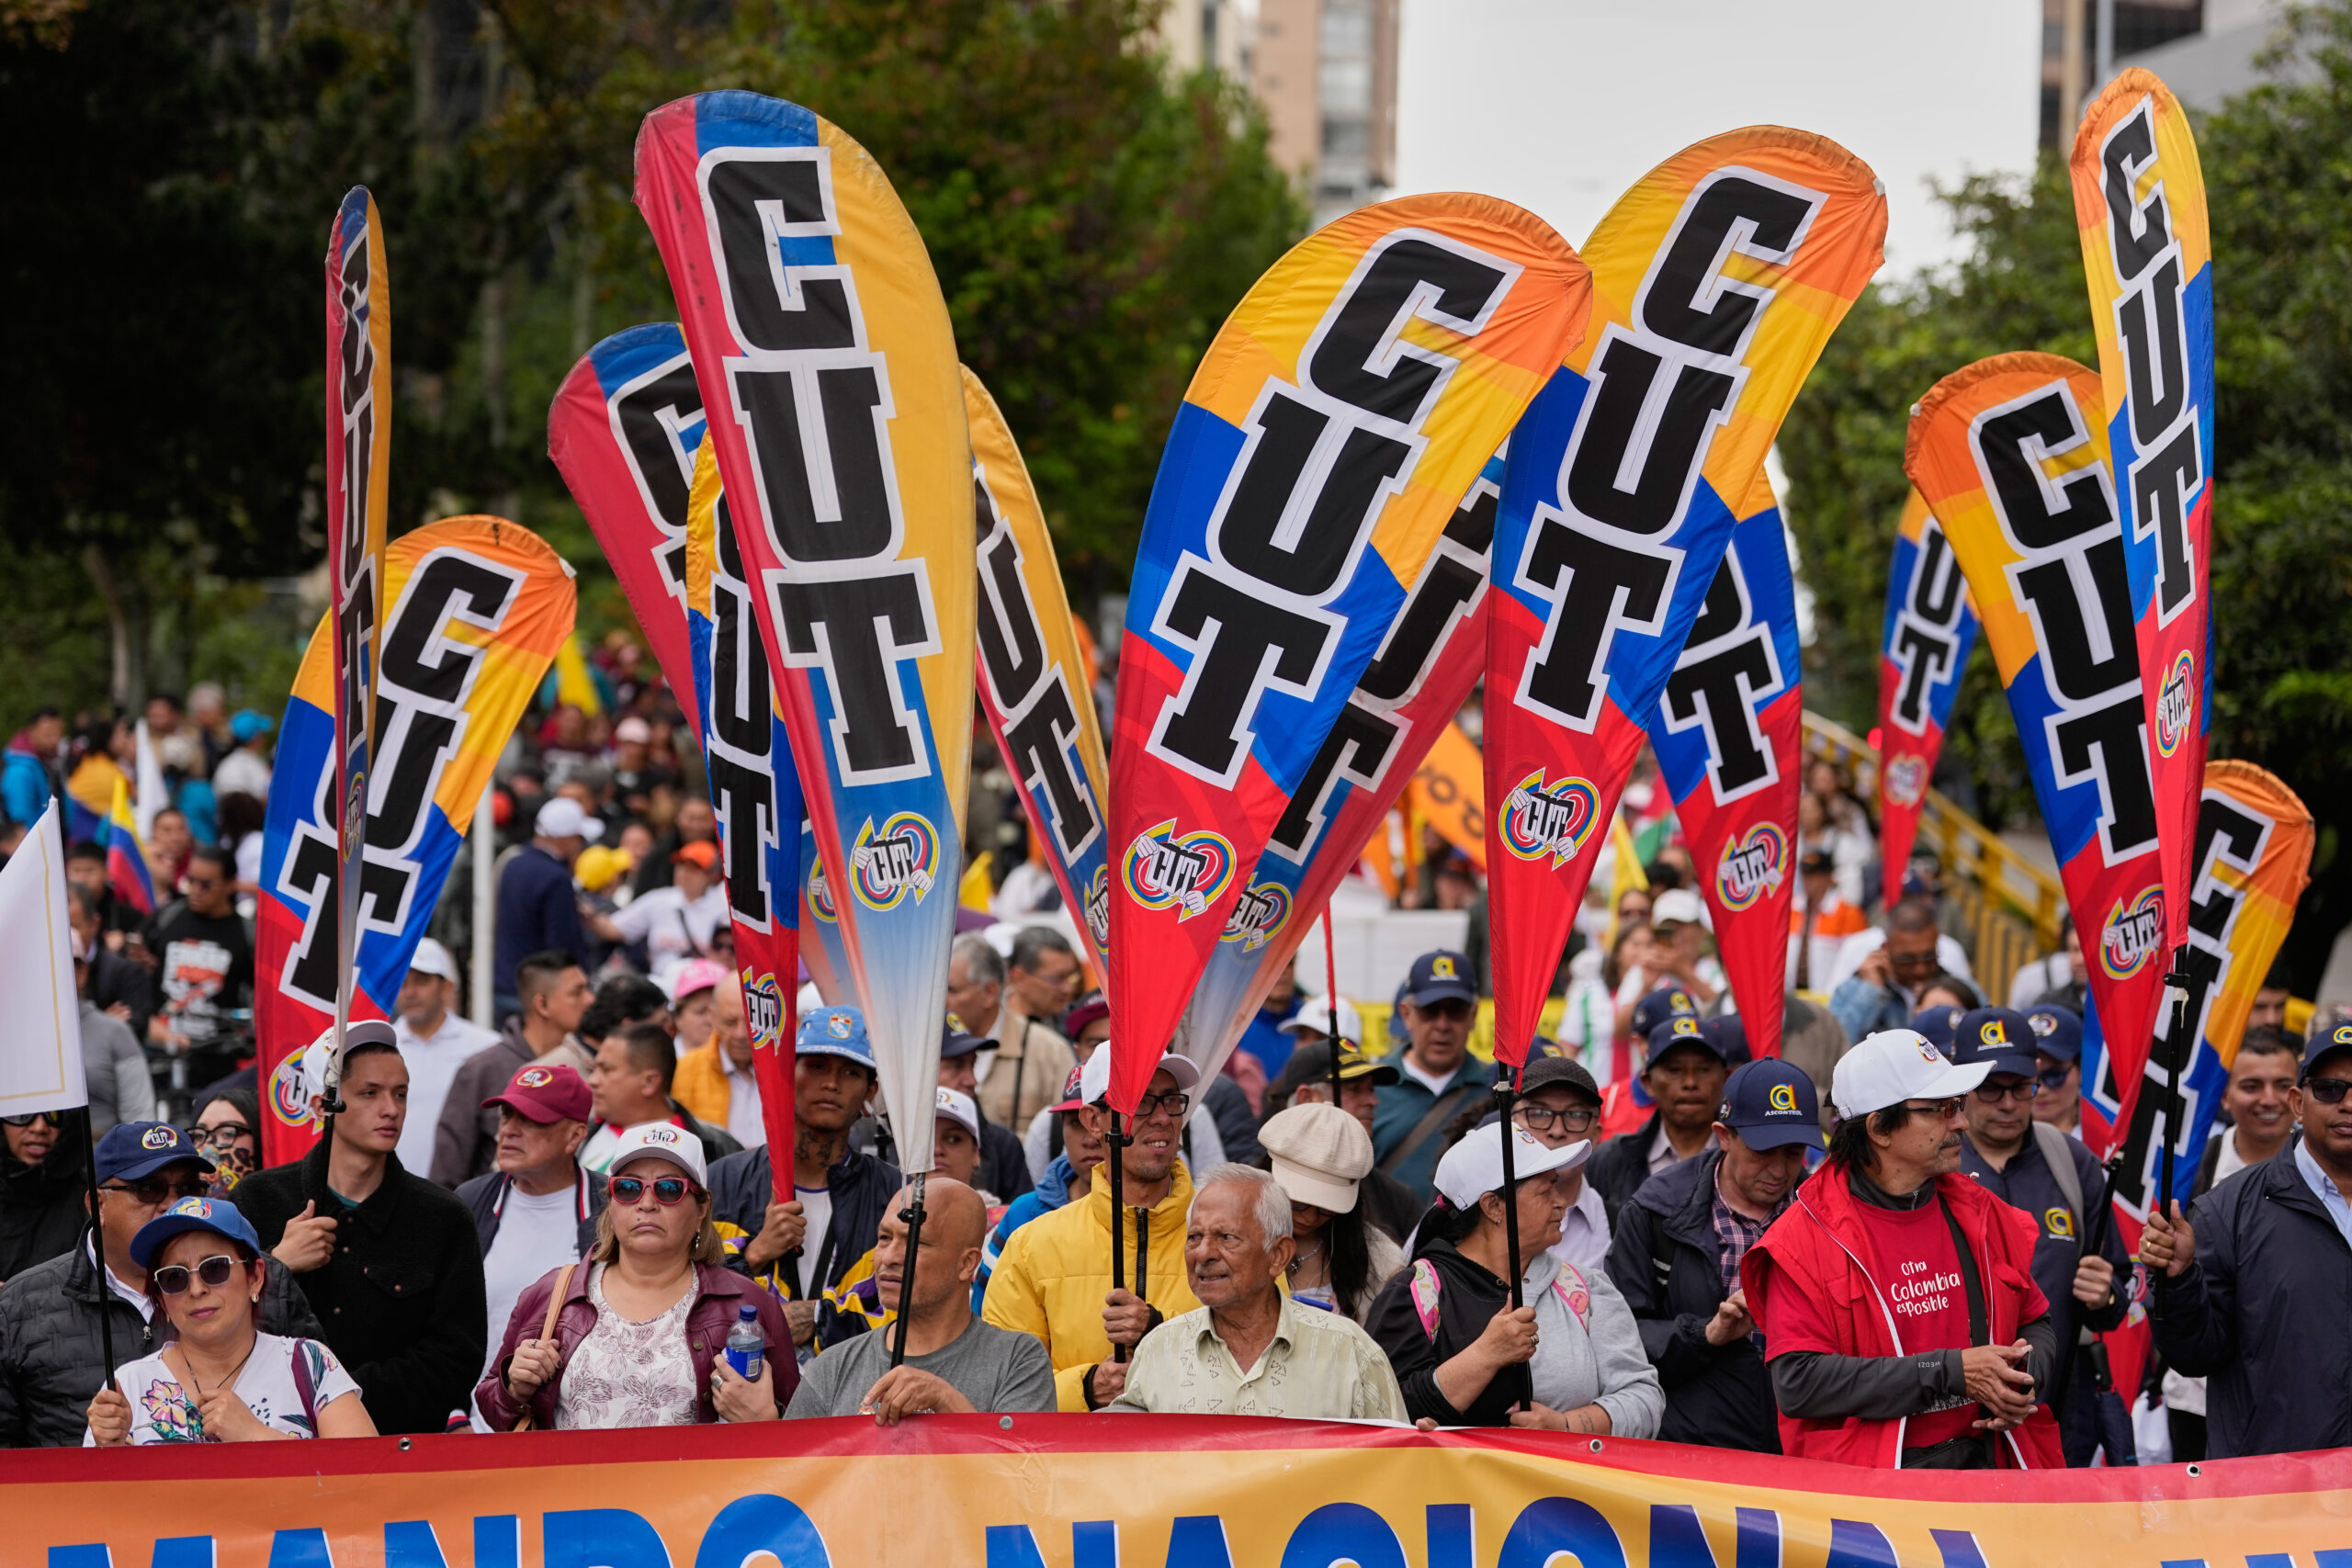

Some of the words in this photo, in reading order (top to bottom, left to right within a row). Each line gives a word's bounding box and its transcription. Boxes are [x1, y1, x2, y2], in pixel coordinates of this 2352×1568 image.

[2103, 97, 2202, 626] CUT
[700, 149, 940, 784] CUT
[1518, 169, 1826, 731] CUT
[341, 226, 374, 761] CUT
[1148, 231, 1521, 788] CUT
[977, 470, 1100, 865] UT
[279, 548, 526, 1010] CUT
[1523, 794, 1575, 846] CUT
[870, 836, 914, 887] CUT
[1147, 842, 1206, 897] CUT
[1733, 844, 1766, 890] CUT
[2117, 908, 2155, 959] CUT
[152, 1132, 169, 1145] CUT
[1891, 1271, 1961, 1302] Colombia
[1901, 1260, 1927, 1276] Otra
